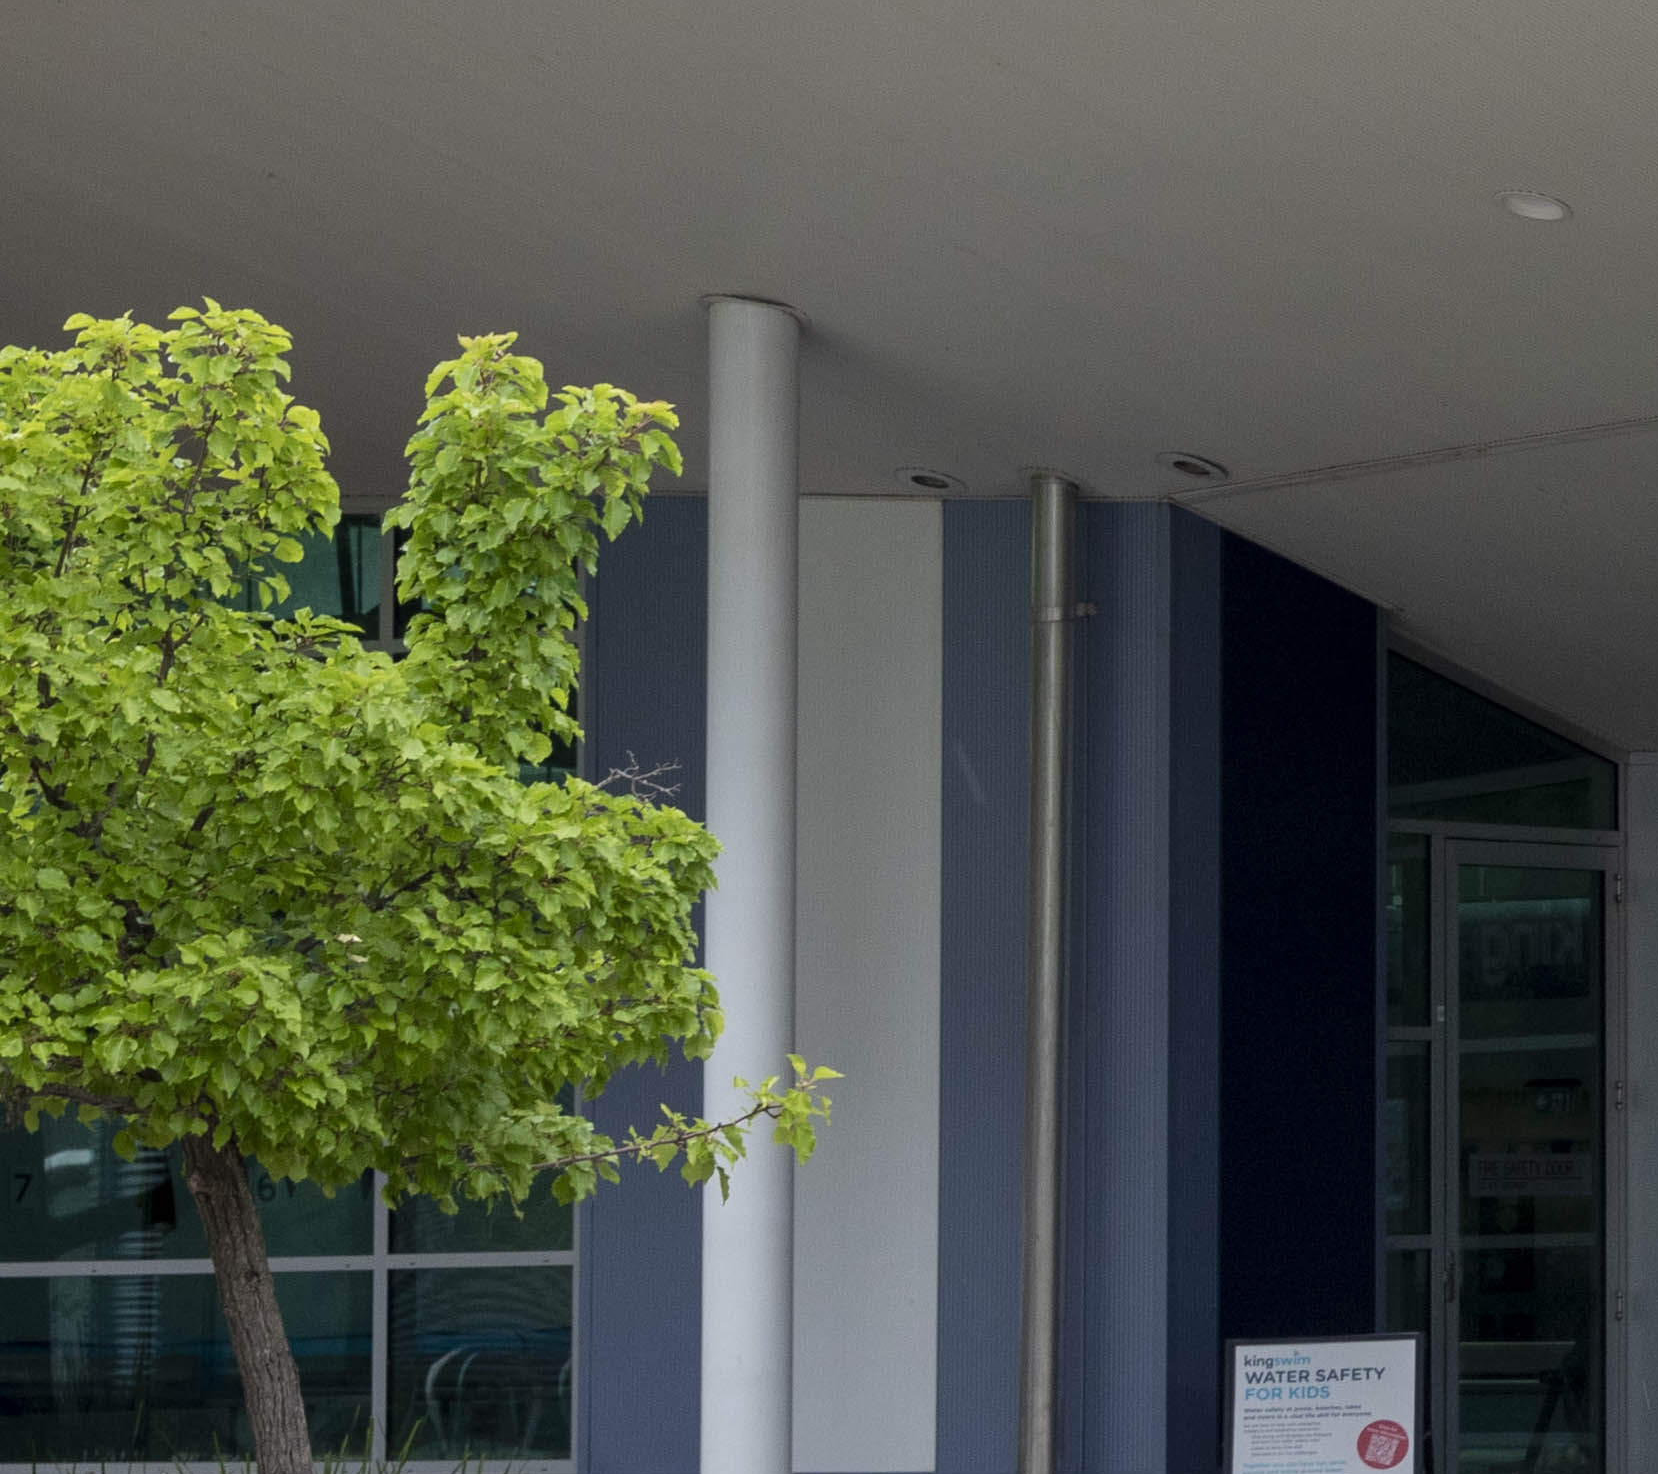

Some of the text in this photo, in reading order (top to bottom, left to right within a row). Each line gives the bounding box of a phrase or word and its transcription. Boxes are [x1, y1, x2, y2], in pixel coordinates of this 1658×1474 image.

[1244, 1353, 1312, 1369] kingswim
[1245, 1367, 1386, 1384] WATER SAFETY
[1244, 1385, 1331, 1401] FOR KIDS
